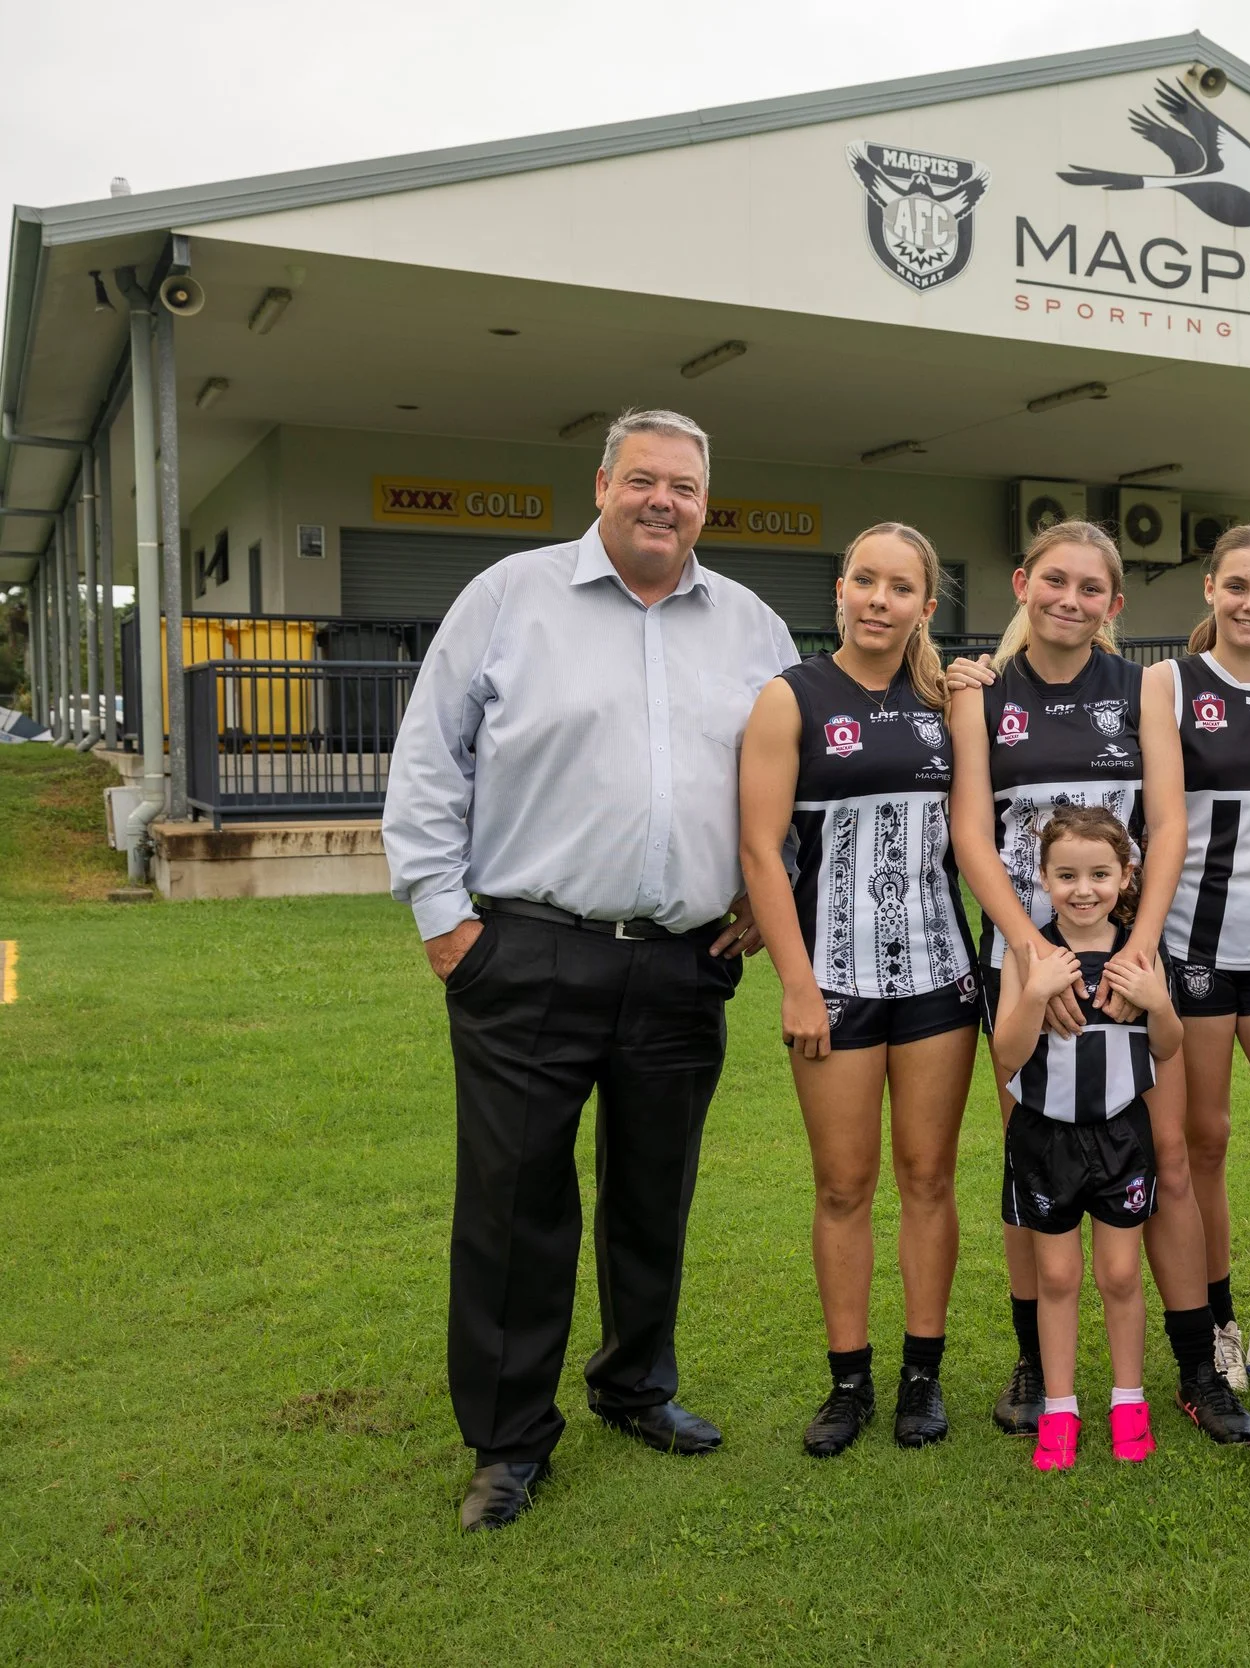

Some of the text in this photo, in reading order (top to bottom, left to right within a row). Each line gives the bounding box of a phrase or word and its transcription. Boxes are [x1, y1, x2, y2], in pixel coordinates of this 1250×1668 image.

[883, 149, 959, 178] MAGPIES
[894, 199, 949, 247] AFC
[896, 263, 945, 288] MACKAY
[1014, 294, 1233, 338] SPORTING
[389, 488, 544, 519] XXXX GOLD
[747, 510, 815, 535] GOLD
[1200, 693, 1217, 701] AFL
[869, 711, 899, 719] LRF
[1045, 703, 1076, 712] LRF
[1201, 703, 1219, 721] Q
[831, 717, 852, 725] AFL
[1002, 715, 1021, 733] Q
[1100, 711, 1118, 725] AFC
[834, 727, 853, 745] Q
[1091, 760, 1134, 768] MAGPIES
[915, 772, 951, 780] MAGPIES
[964, 974, 977, 993] Q
[1190, 975, 1207, 988] AFC
